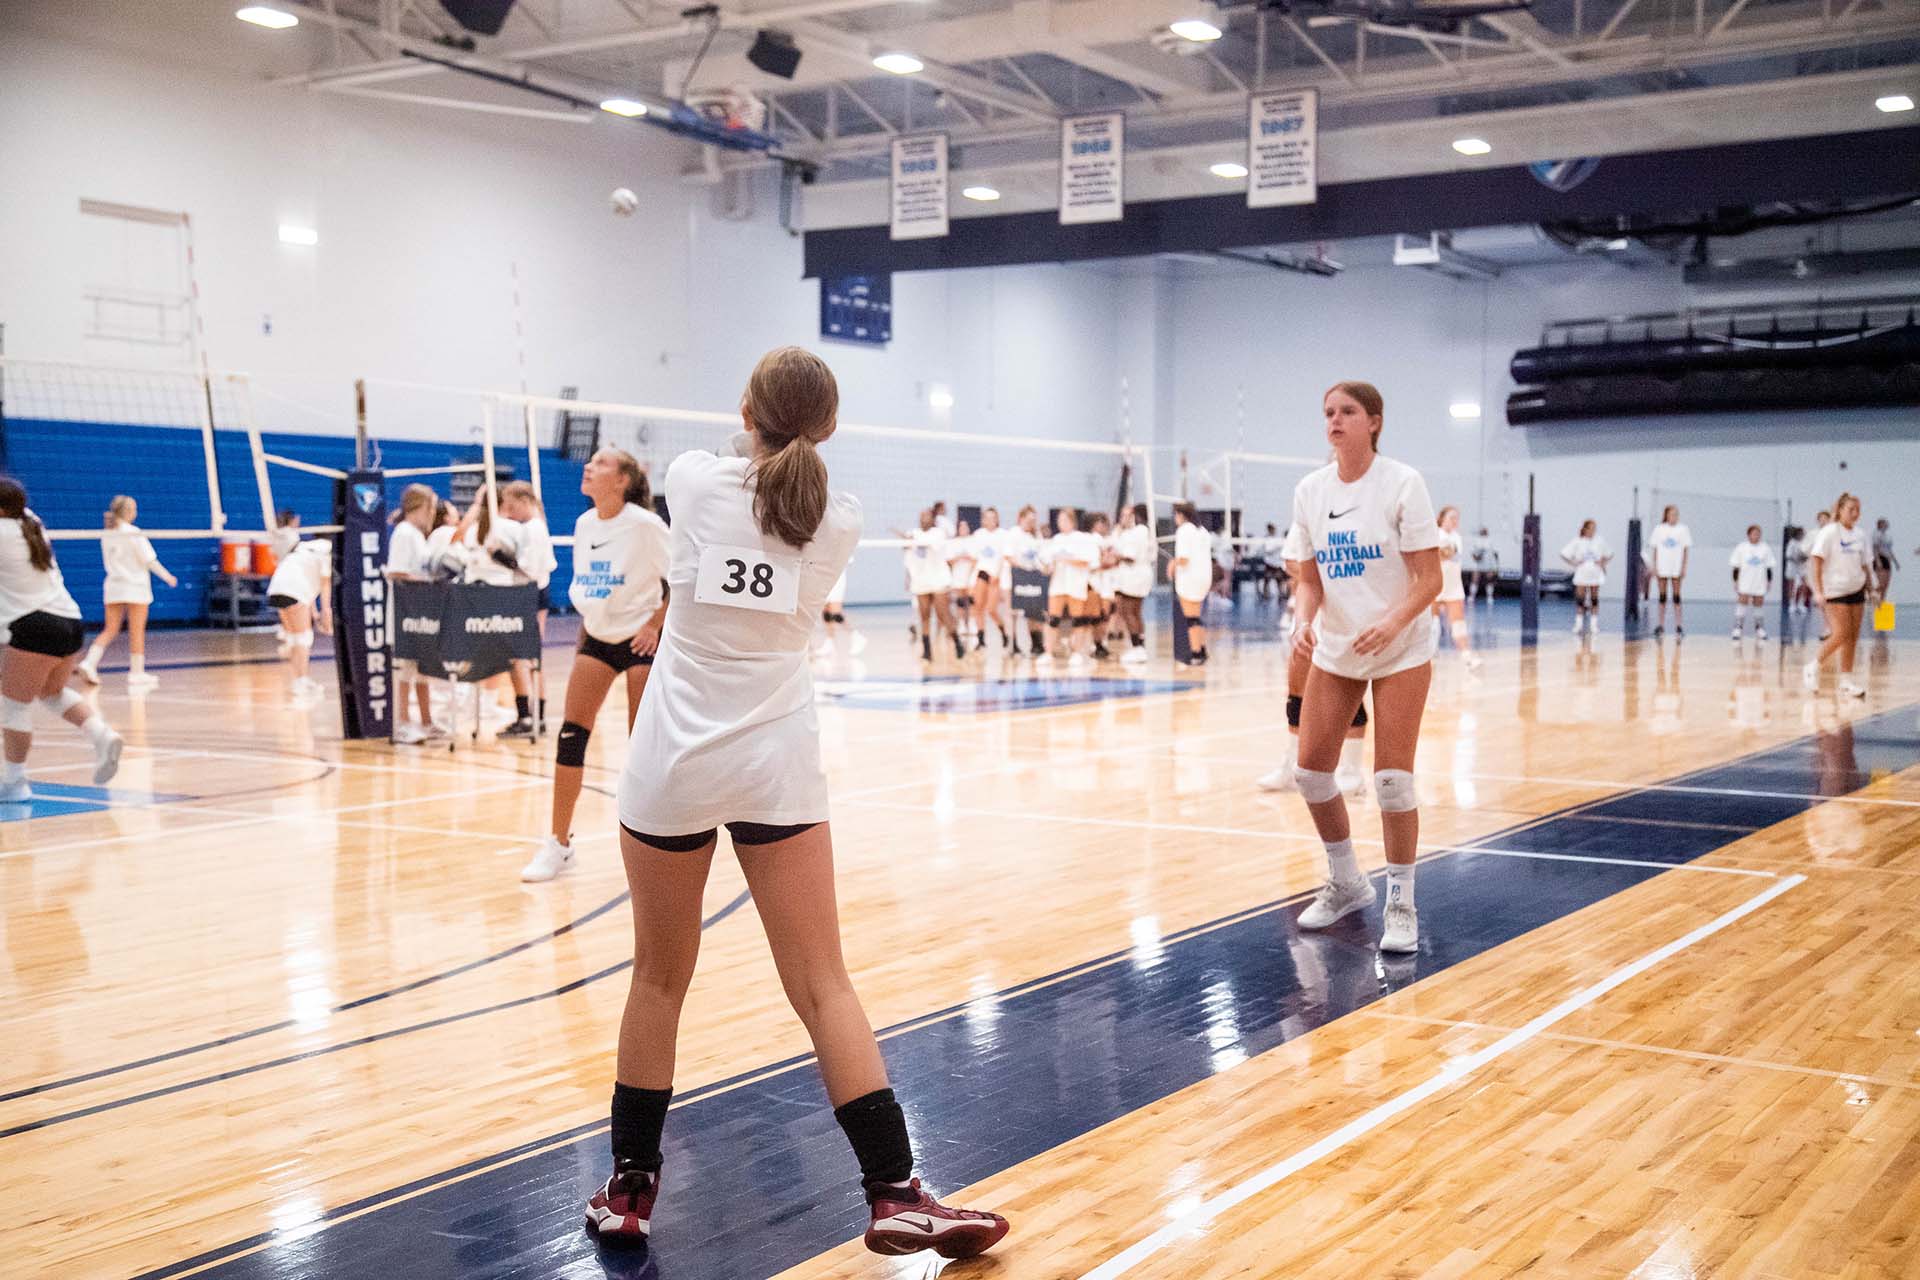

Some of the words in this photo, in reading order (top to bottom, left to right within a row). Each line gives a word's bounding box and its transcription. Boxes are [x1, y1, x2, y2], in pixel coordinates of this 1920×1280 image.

[1328, 530, 1357, 545] NIKE
[721, 559, 774, 598] 38
[1328, 561, 1365, 579] CAMP
[360, 531, 387, 722] ELMHURST
[465, 615, 523, 633] molten
